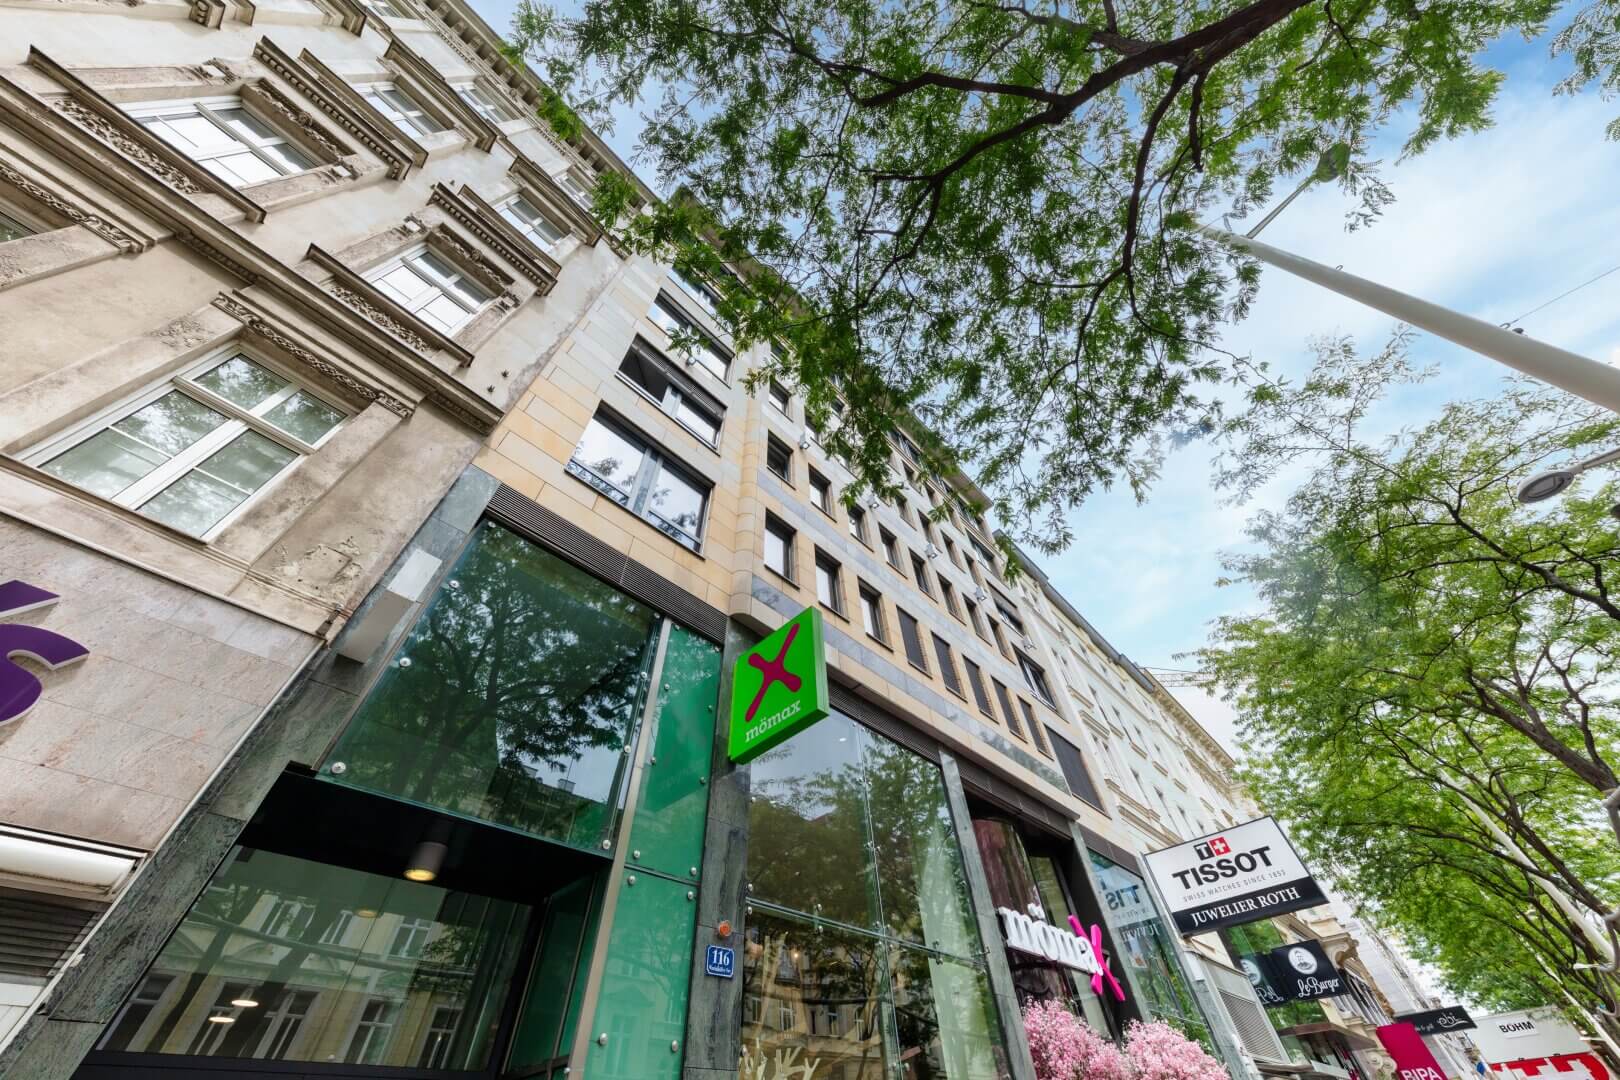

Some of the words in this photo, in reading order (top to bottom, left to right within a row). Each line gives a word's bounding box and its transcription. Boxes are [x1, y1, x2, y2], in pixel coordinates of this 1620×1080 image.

[745, 700, 801, 742] mömax
[1172, 846, 1273, 890] TISSOT
[1184, 891, 1206, 902] SWISS
[1208, 880, 1242, 897] WATCHES
[1243, 874, 1267, 887] SINCE
[1190, 898, 1255, 927] JUWELIER
[1256, 886, 1301, 908] ROTH
[712, 949, 730, 966] 116
[1400, 1066, 1443, 1080] BIPA
